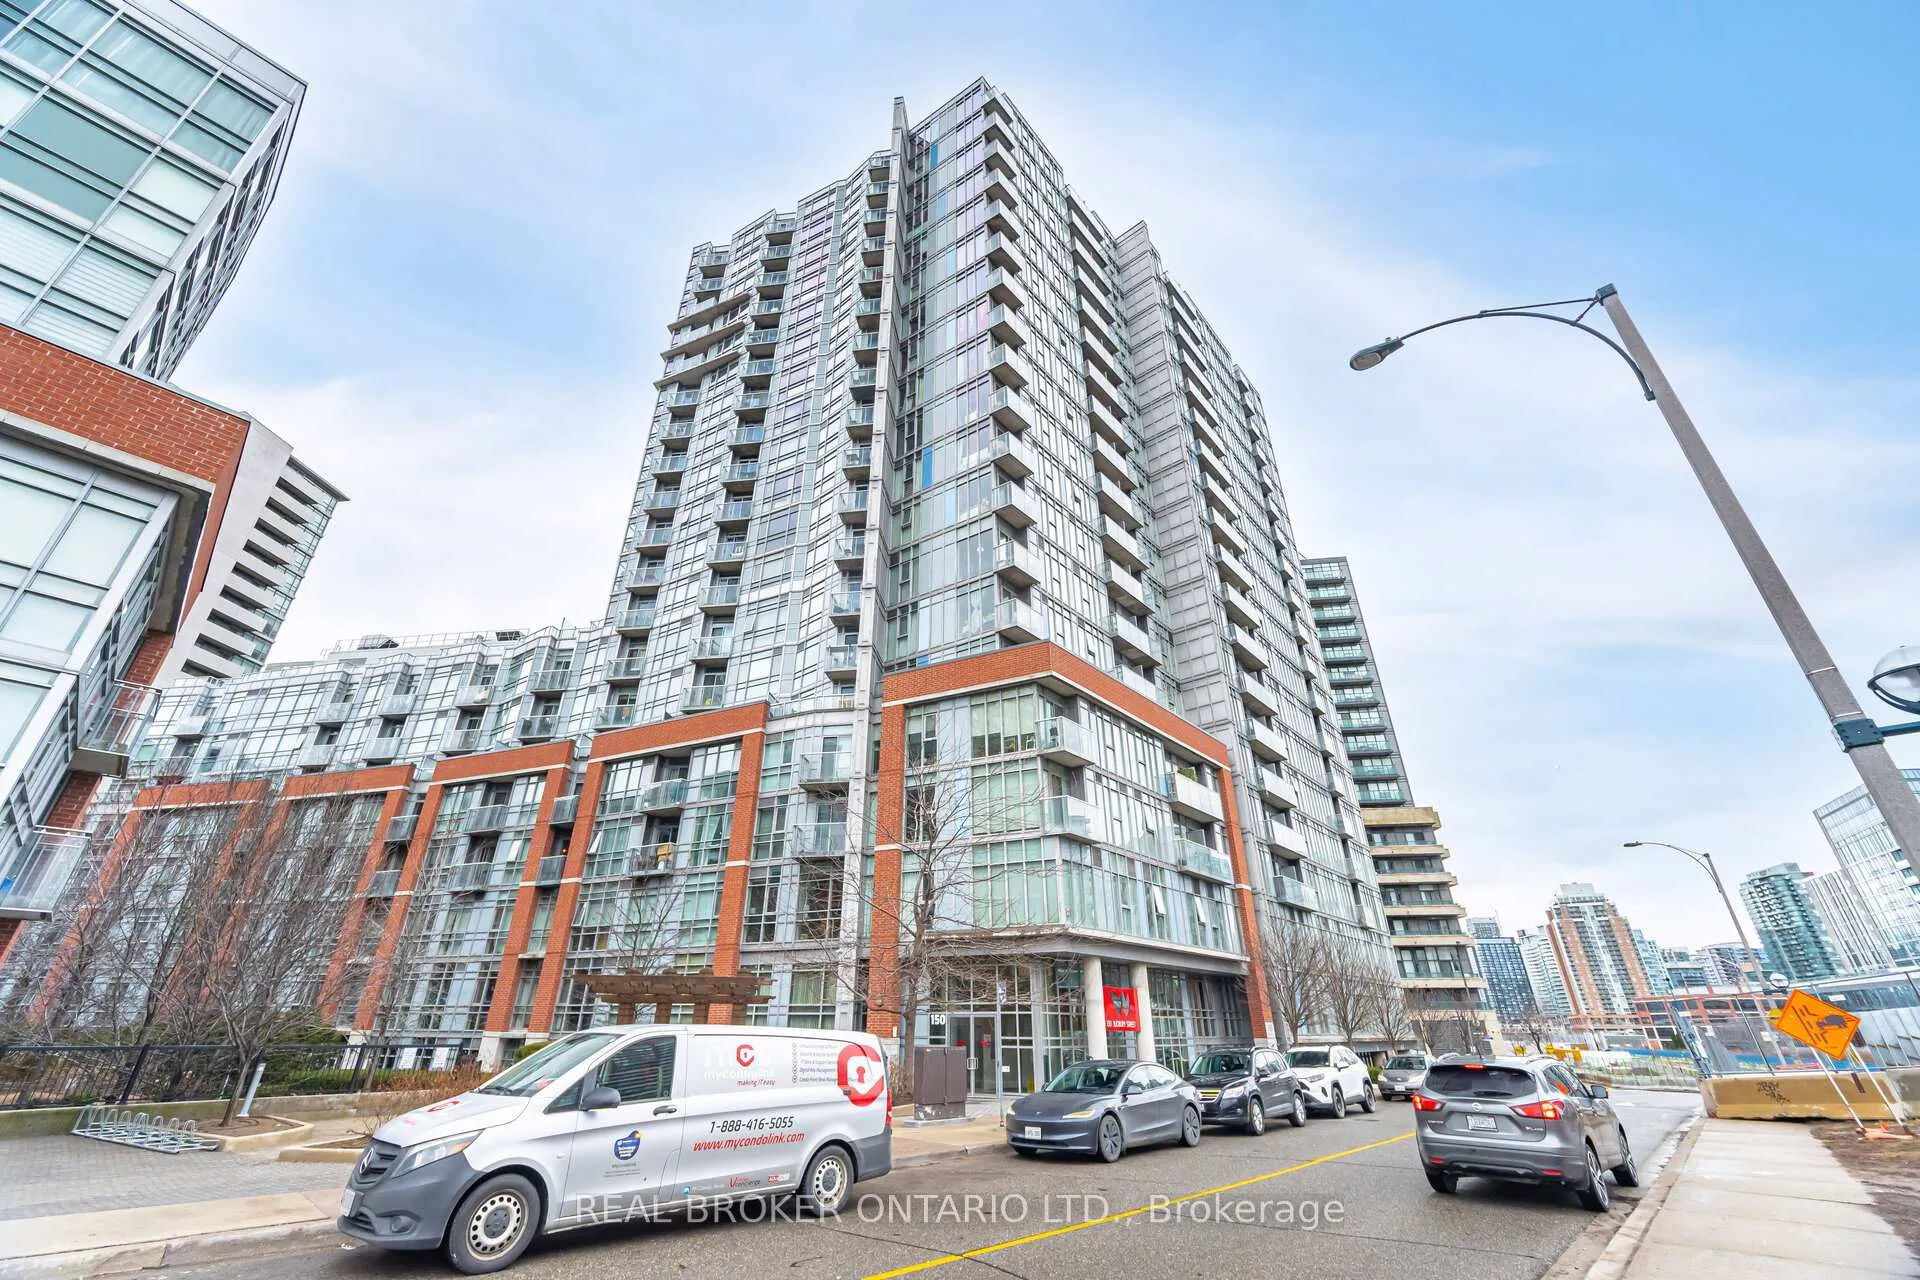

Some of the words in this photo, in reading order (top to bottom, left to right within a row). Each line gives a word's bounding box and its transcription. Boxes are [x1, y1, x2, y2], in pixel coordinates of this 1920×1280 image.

[930, 1014, 946, 1025] 150
[710, 1116, 794, 1134] 1-888-416-5055
[693, 1132, 805, 1152] www.mycondolink.com
